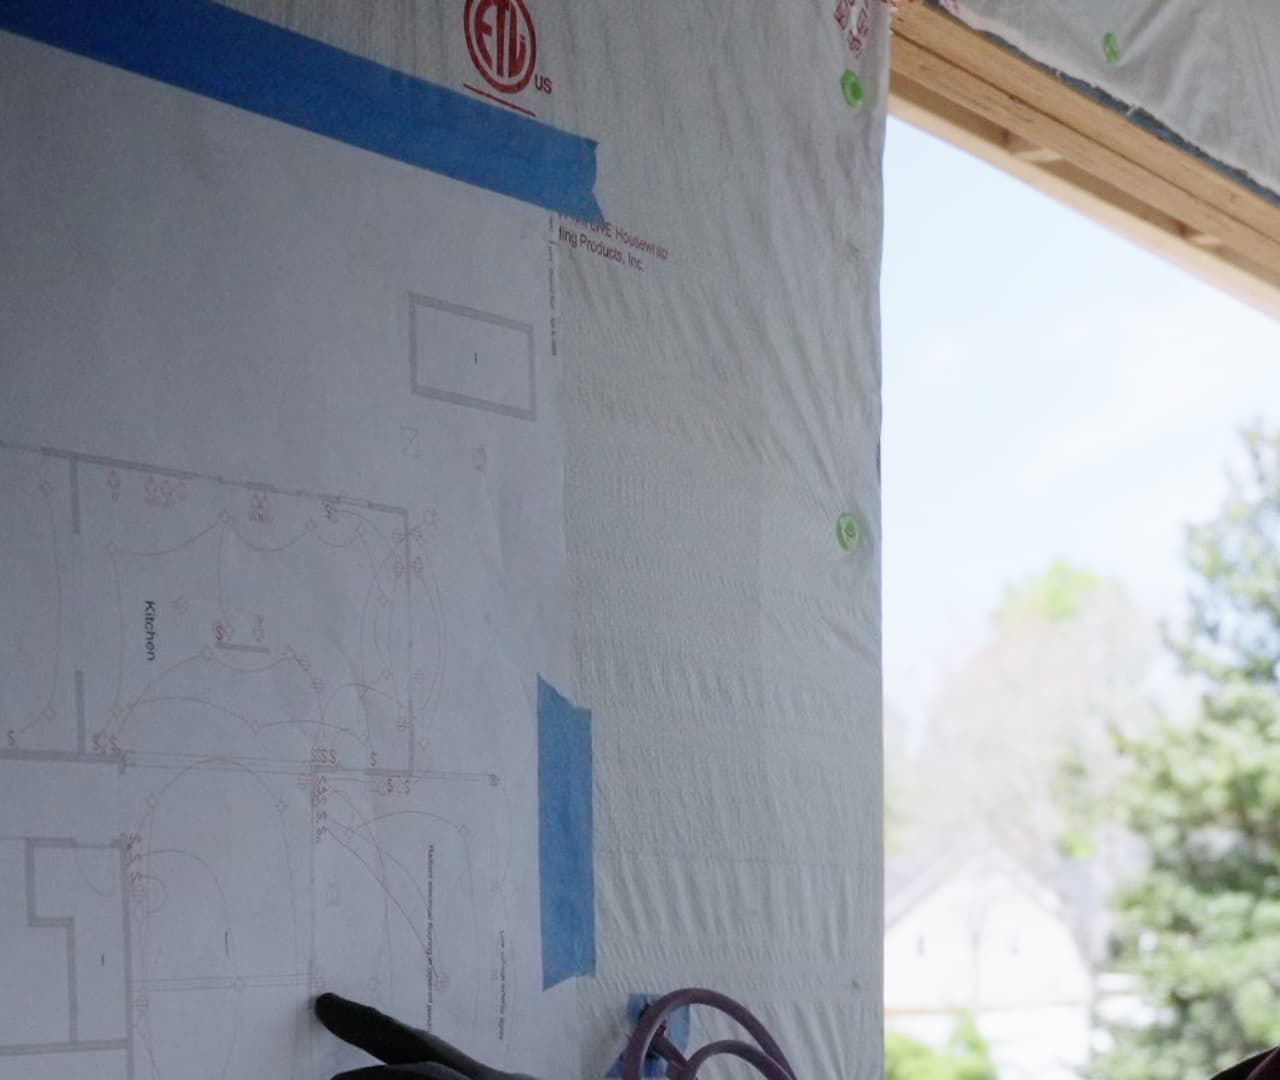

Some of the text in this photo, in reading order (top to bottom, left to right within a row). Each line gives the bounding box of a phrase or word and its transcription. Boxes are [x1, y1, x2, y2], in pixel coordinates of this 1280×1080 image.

[534, 74, 552, 95] US
[628, 251, 645, 273] Inc.
[143, 600, 158, 662] Kitchen
